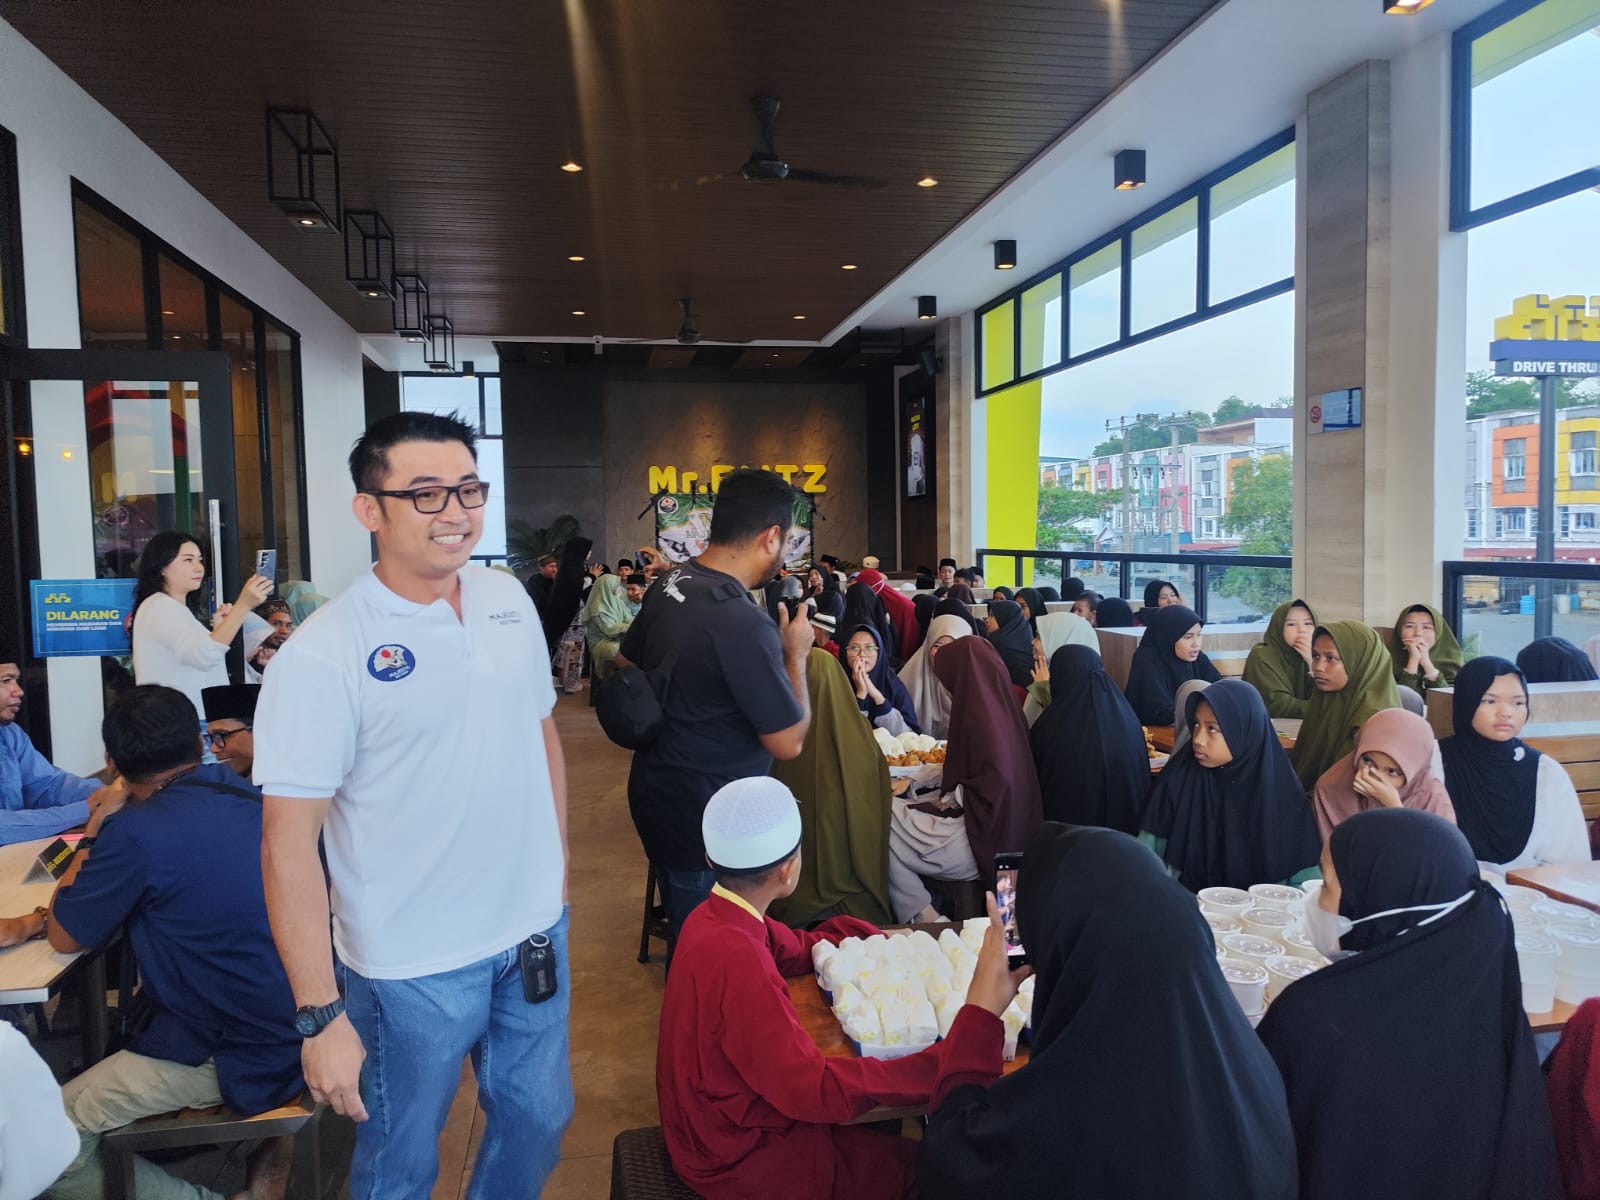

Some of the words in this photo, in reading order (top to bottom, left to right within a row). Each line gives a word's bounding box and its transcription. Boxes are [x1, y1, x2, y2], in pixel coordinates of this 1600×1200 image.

[1513, 361, 1556, 373] DRIVE
[1558, 362, 1598, 373] THRU
[649, 464, 827, 494] Mr.TZ
[46, 609, 120, 621] DILARANG
